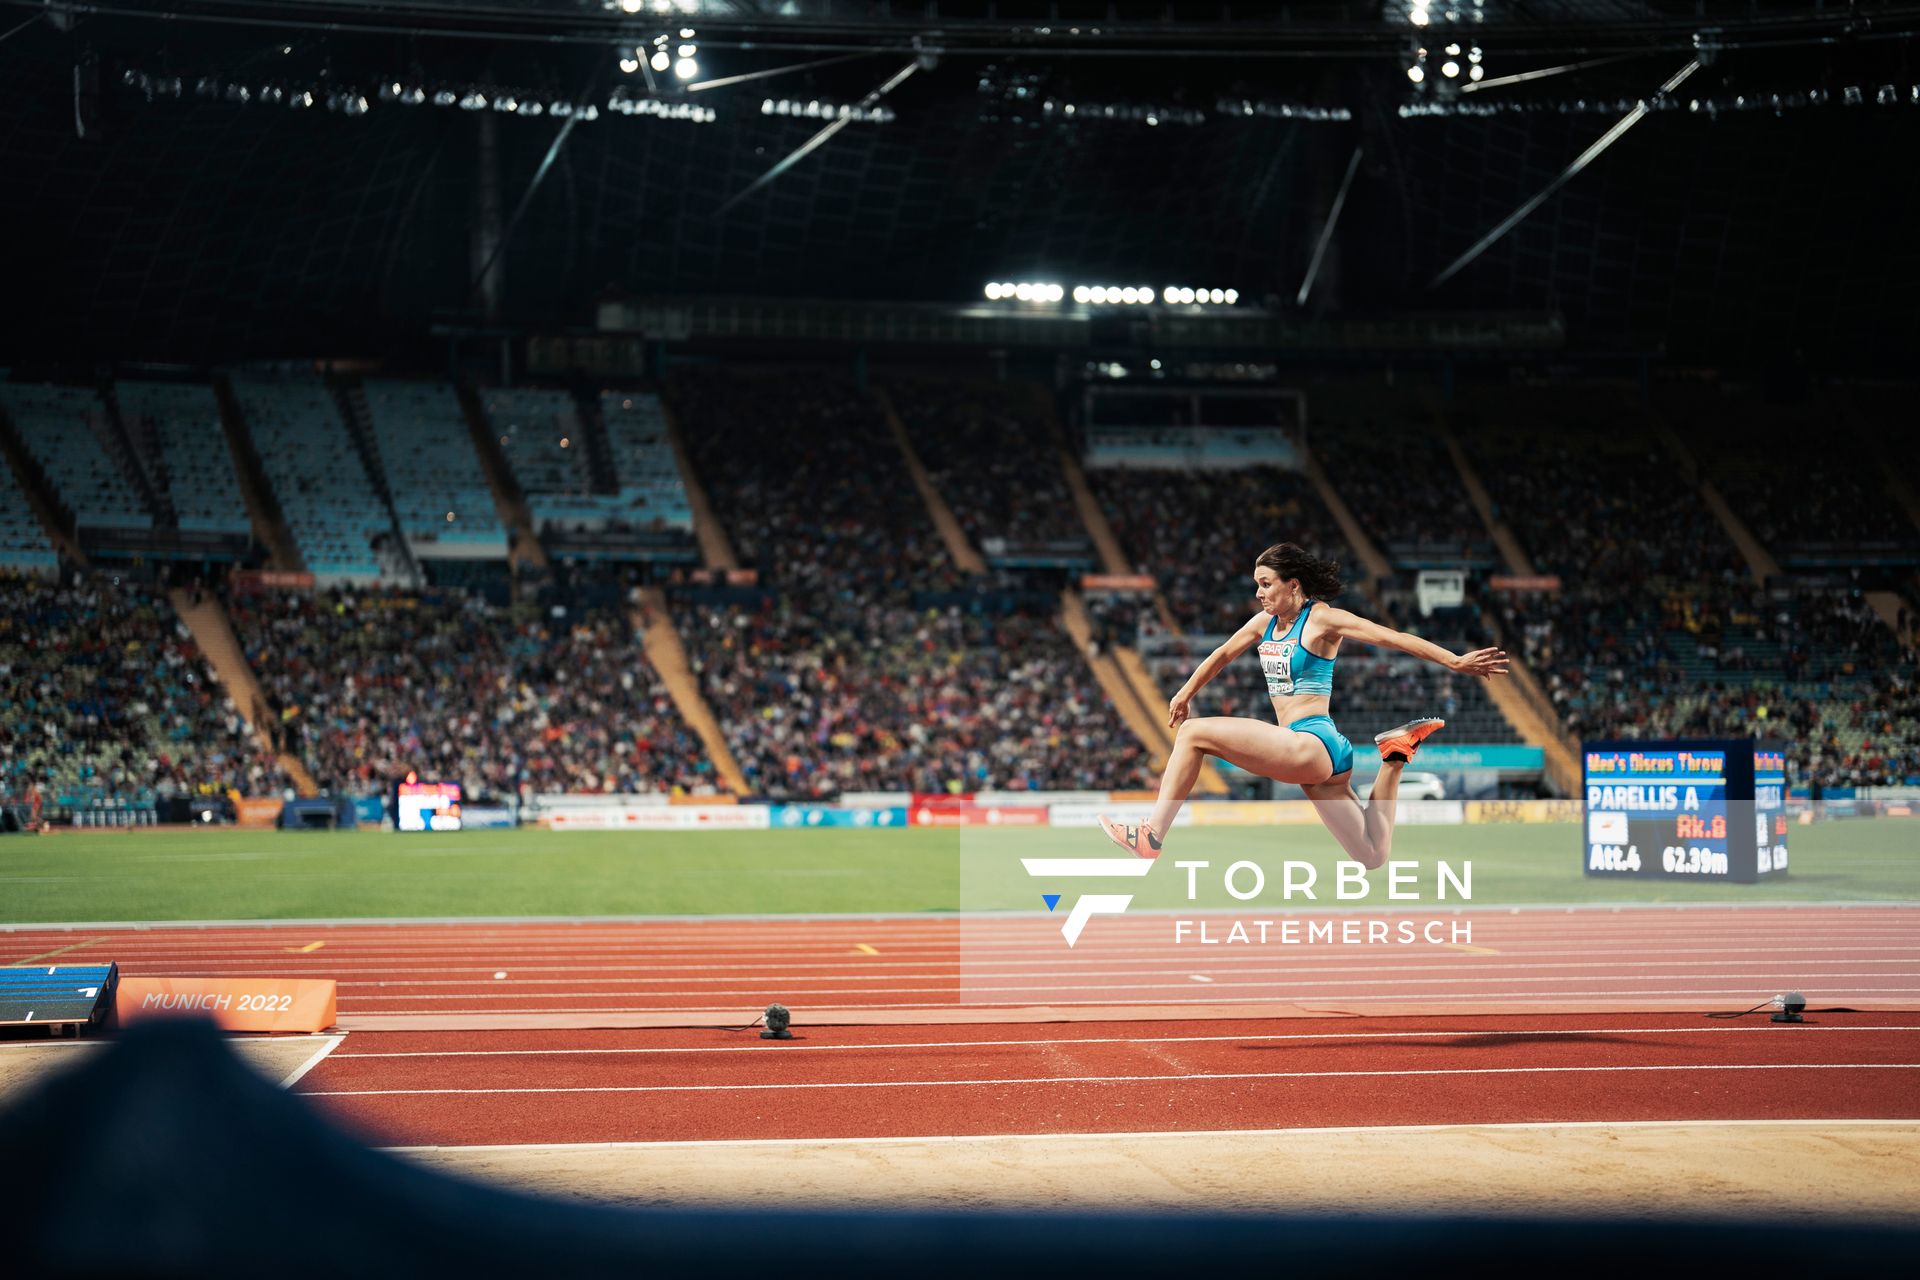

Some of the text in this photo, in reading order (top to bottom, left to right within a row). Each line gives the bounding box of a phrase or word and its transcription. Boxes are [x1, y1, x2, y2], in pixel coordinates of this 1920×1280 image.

[1630, 753, 1674, 772] Discus
[1678, 752, 1723, 772] Throw
[1588, 786, 1678, 811] PARELLIS
[1684, 786, 1699, 811] A
[1590, 844, 1641, 871] Att.4
[1662, 846, 1729, 874] 62.39m
[142, 993, 292, 1012] MUNICH 2022
